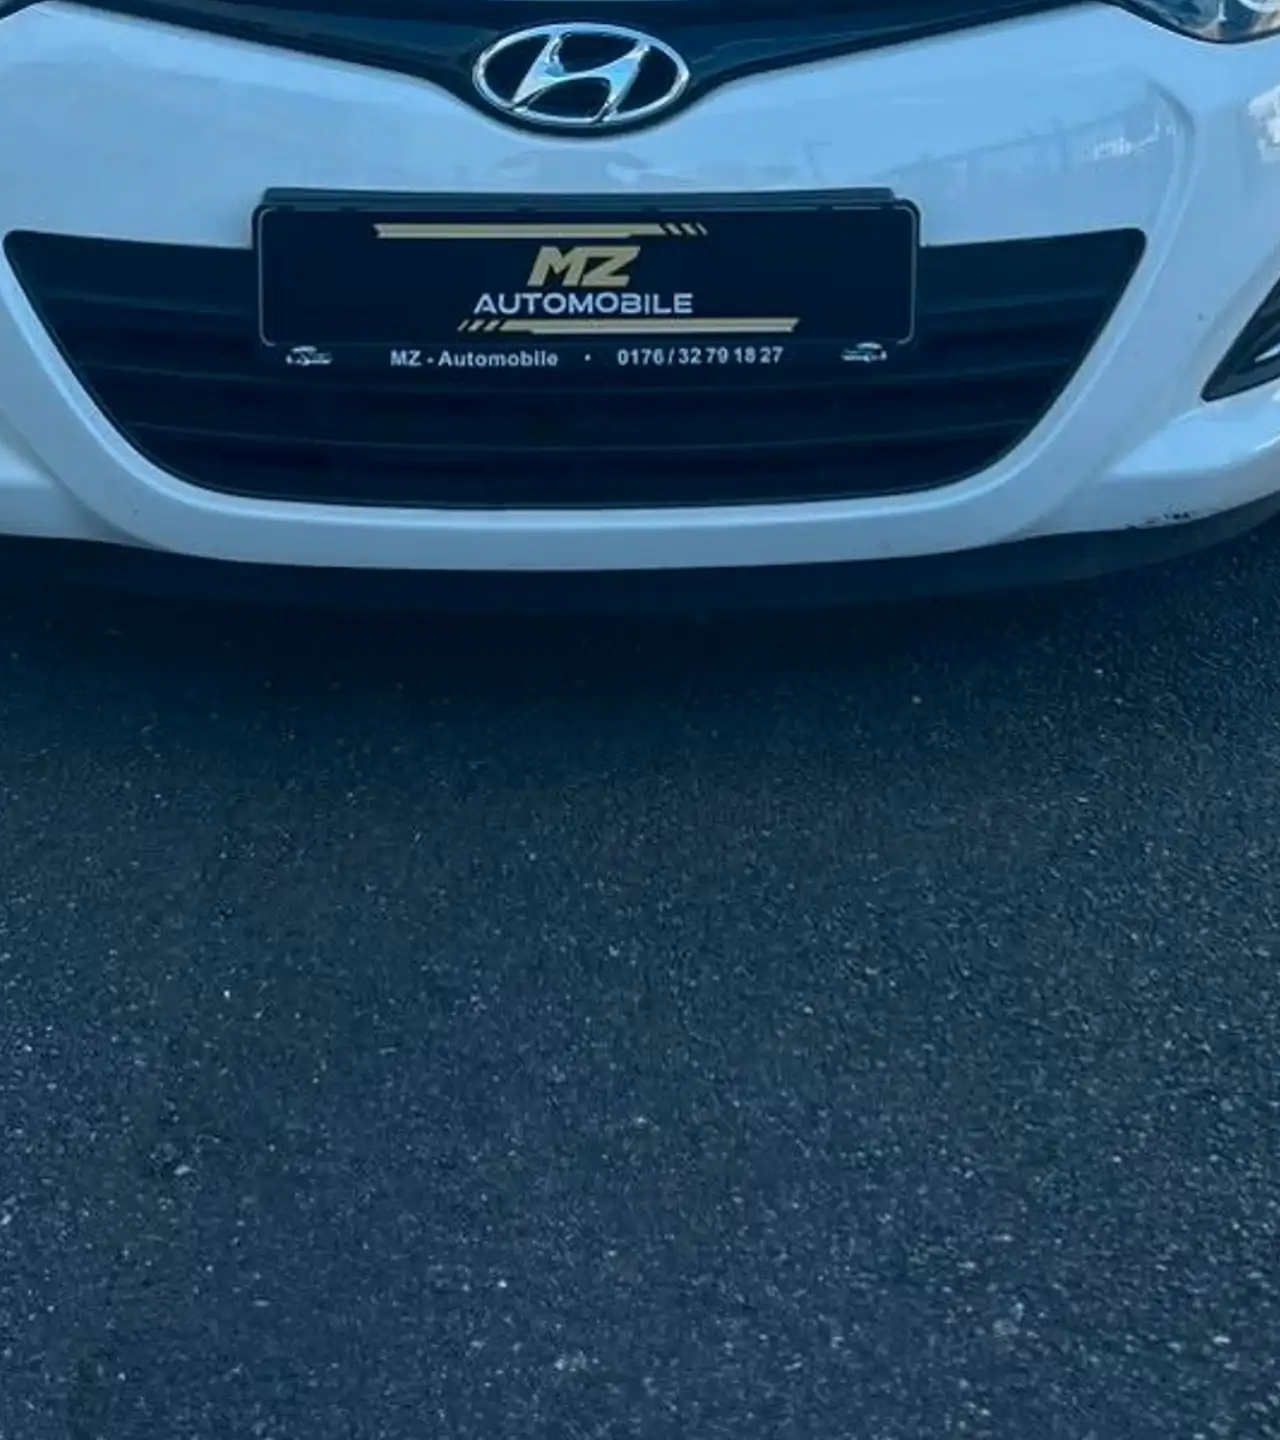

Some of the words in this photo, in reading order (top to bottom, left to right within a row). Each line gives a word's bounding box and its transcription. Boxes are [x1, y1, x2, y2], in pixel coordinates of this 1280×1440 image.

[527, 246, 641, 287] MZ
[473, 292, 694, 314] AUTOMOBILE
[389, 349, 422, 367] MZ
[437, 349, 559, 367] Automobile
